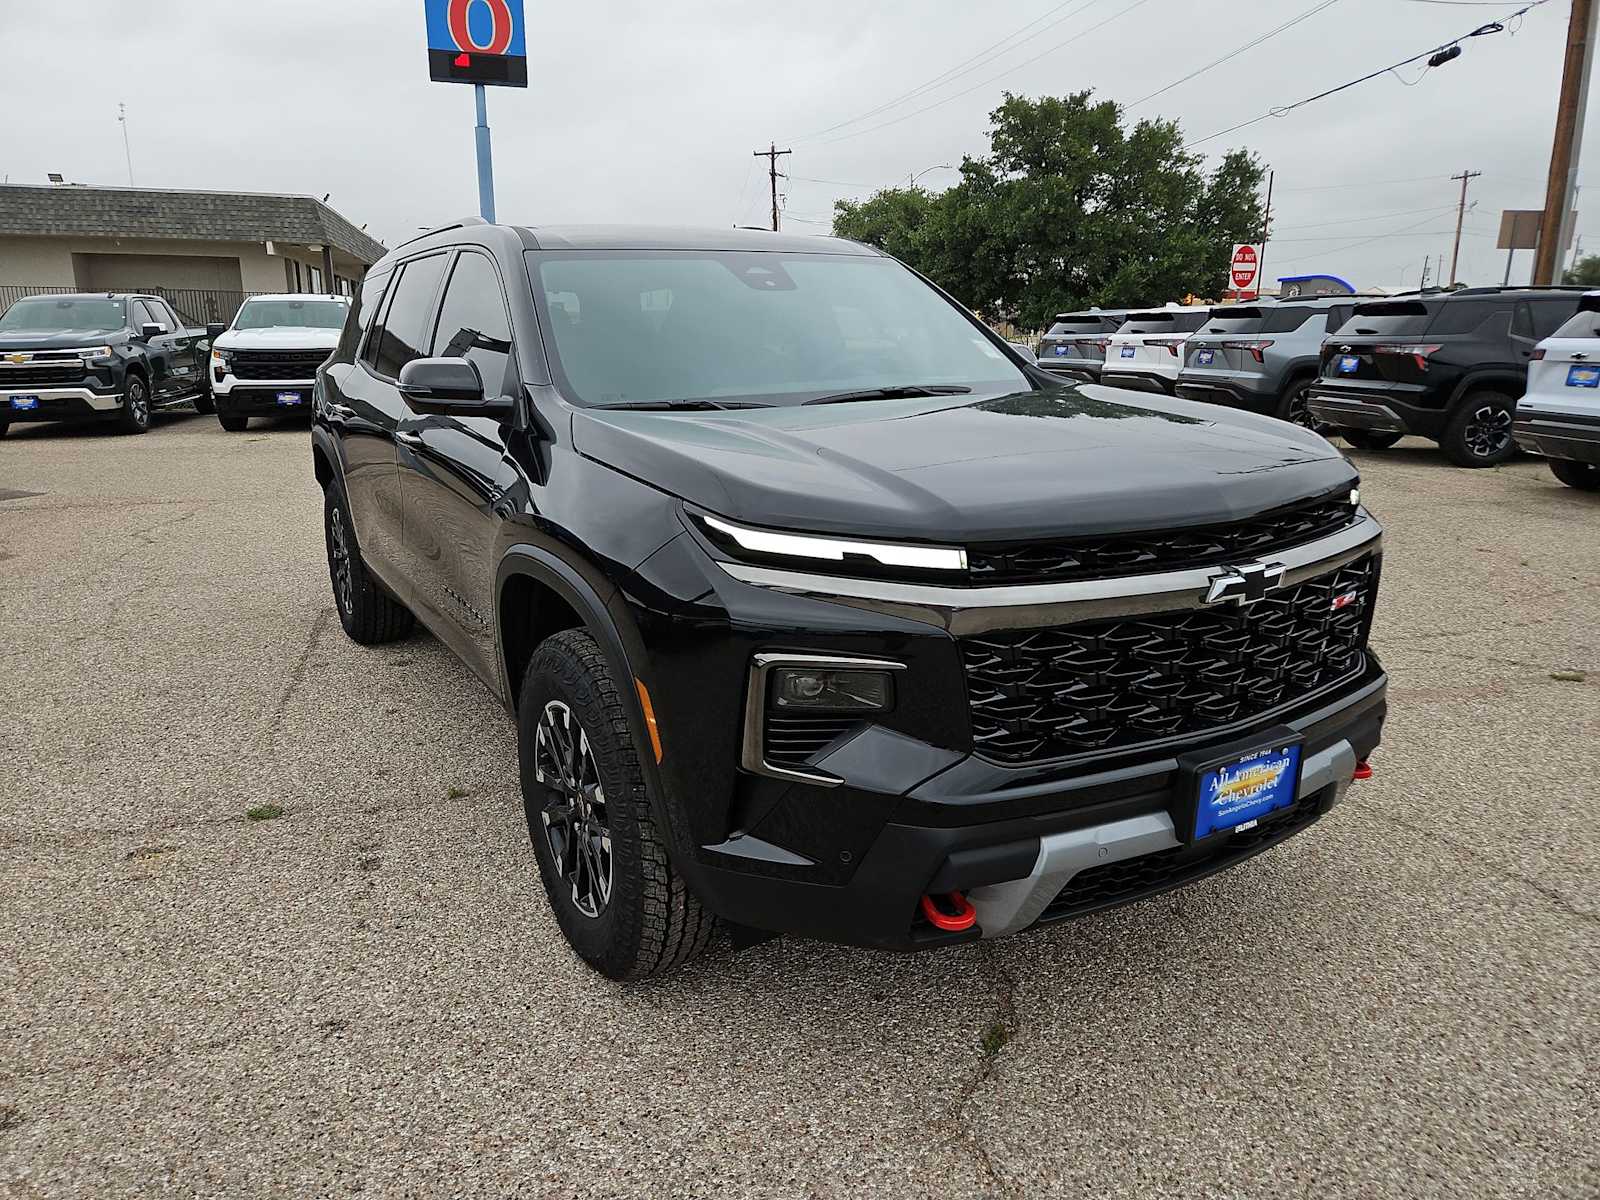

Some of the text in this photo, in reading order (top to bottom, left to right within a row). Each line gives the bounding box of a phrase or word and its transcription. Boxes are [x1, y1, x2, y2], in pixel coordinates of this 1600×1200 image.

[1235, 253, 1255, 261] DO NOT
[1235, 272, 1252, 281] ENTER
[1240, 752, 1258, 763] SINCE
[1209, 757, 1290, 791] All American
[1219, 777, 1278, 805] Chevrolet
